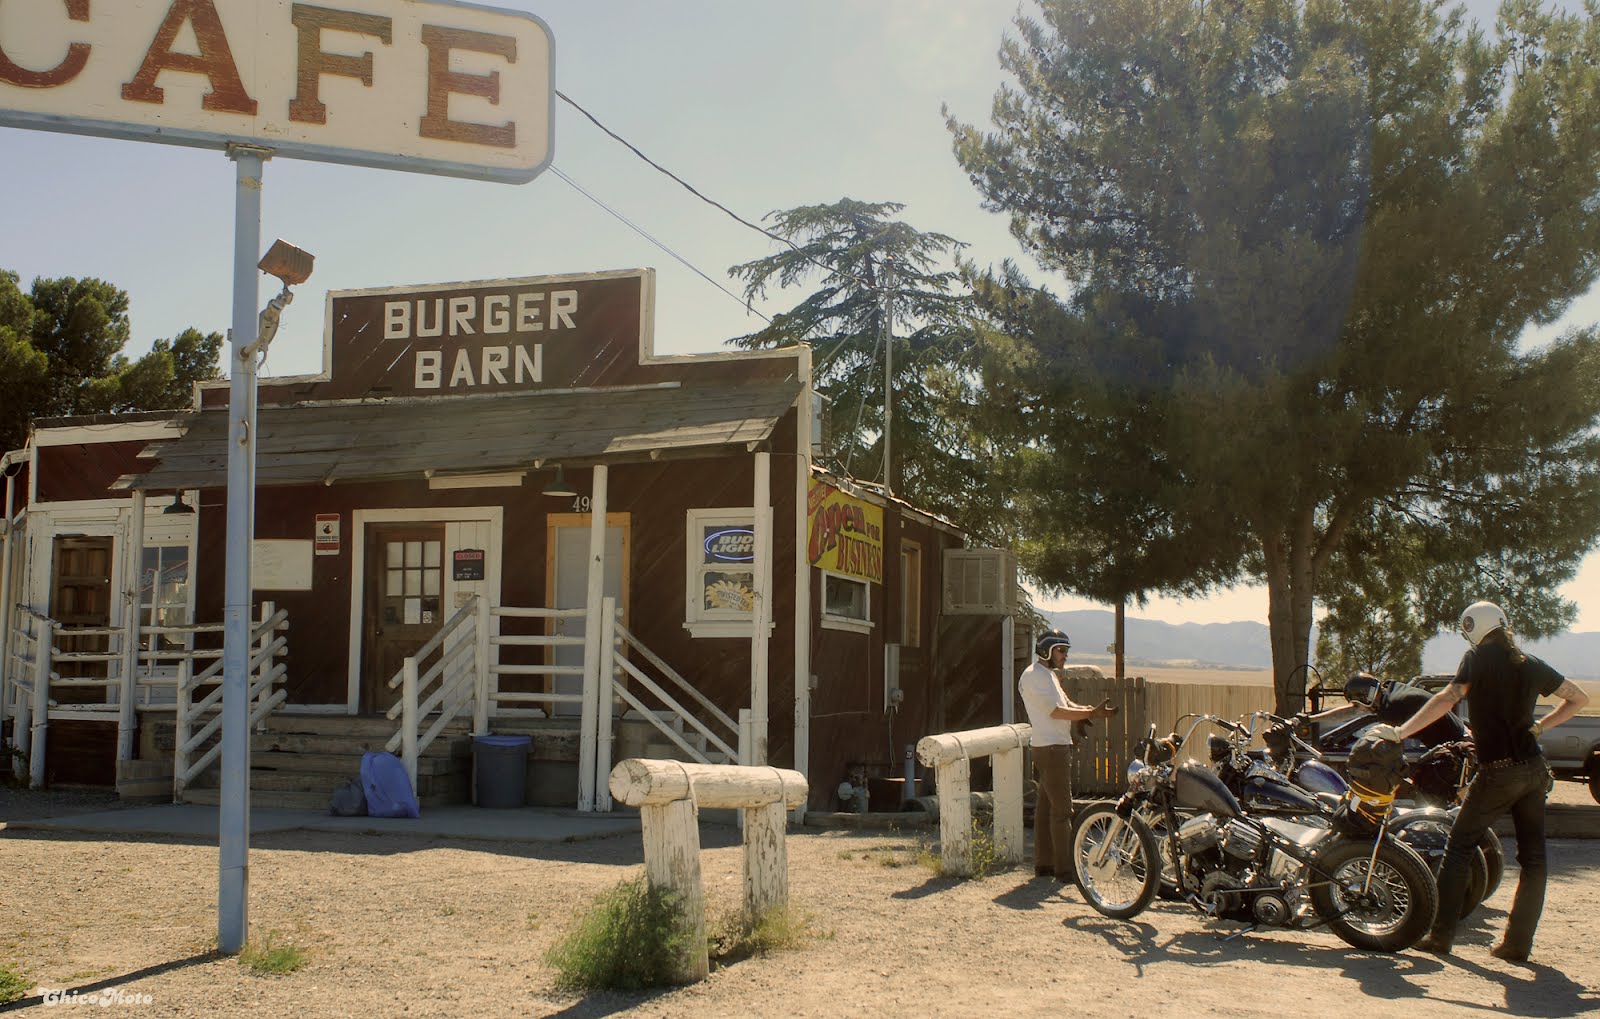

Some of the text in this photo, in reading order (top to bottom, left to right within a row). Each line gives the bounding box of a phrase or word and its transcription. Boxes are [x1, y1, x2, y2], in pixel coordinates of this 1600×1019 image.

[0, 0, 516, 148] CAFE
[384, 290, 578, 340] BURGER
[414, 344, 543, 389] BARN
[573, 496, 593, 512] 49
[719, 535, 753, 544] BUD
[866, 522, 880, 541] FOR
[836, 535, 881, 581] BUSINESS
[717, 590, 741, 602] TWISTED
